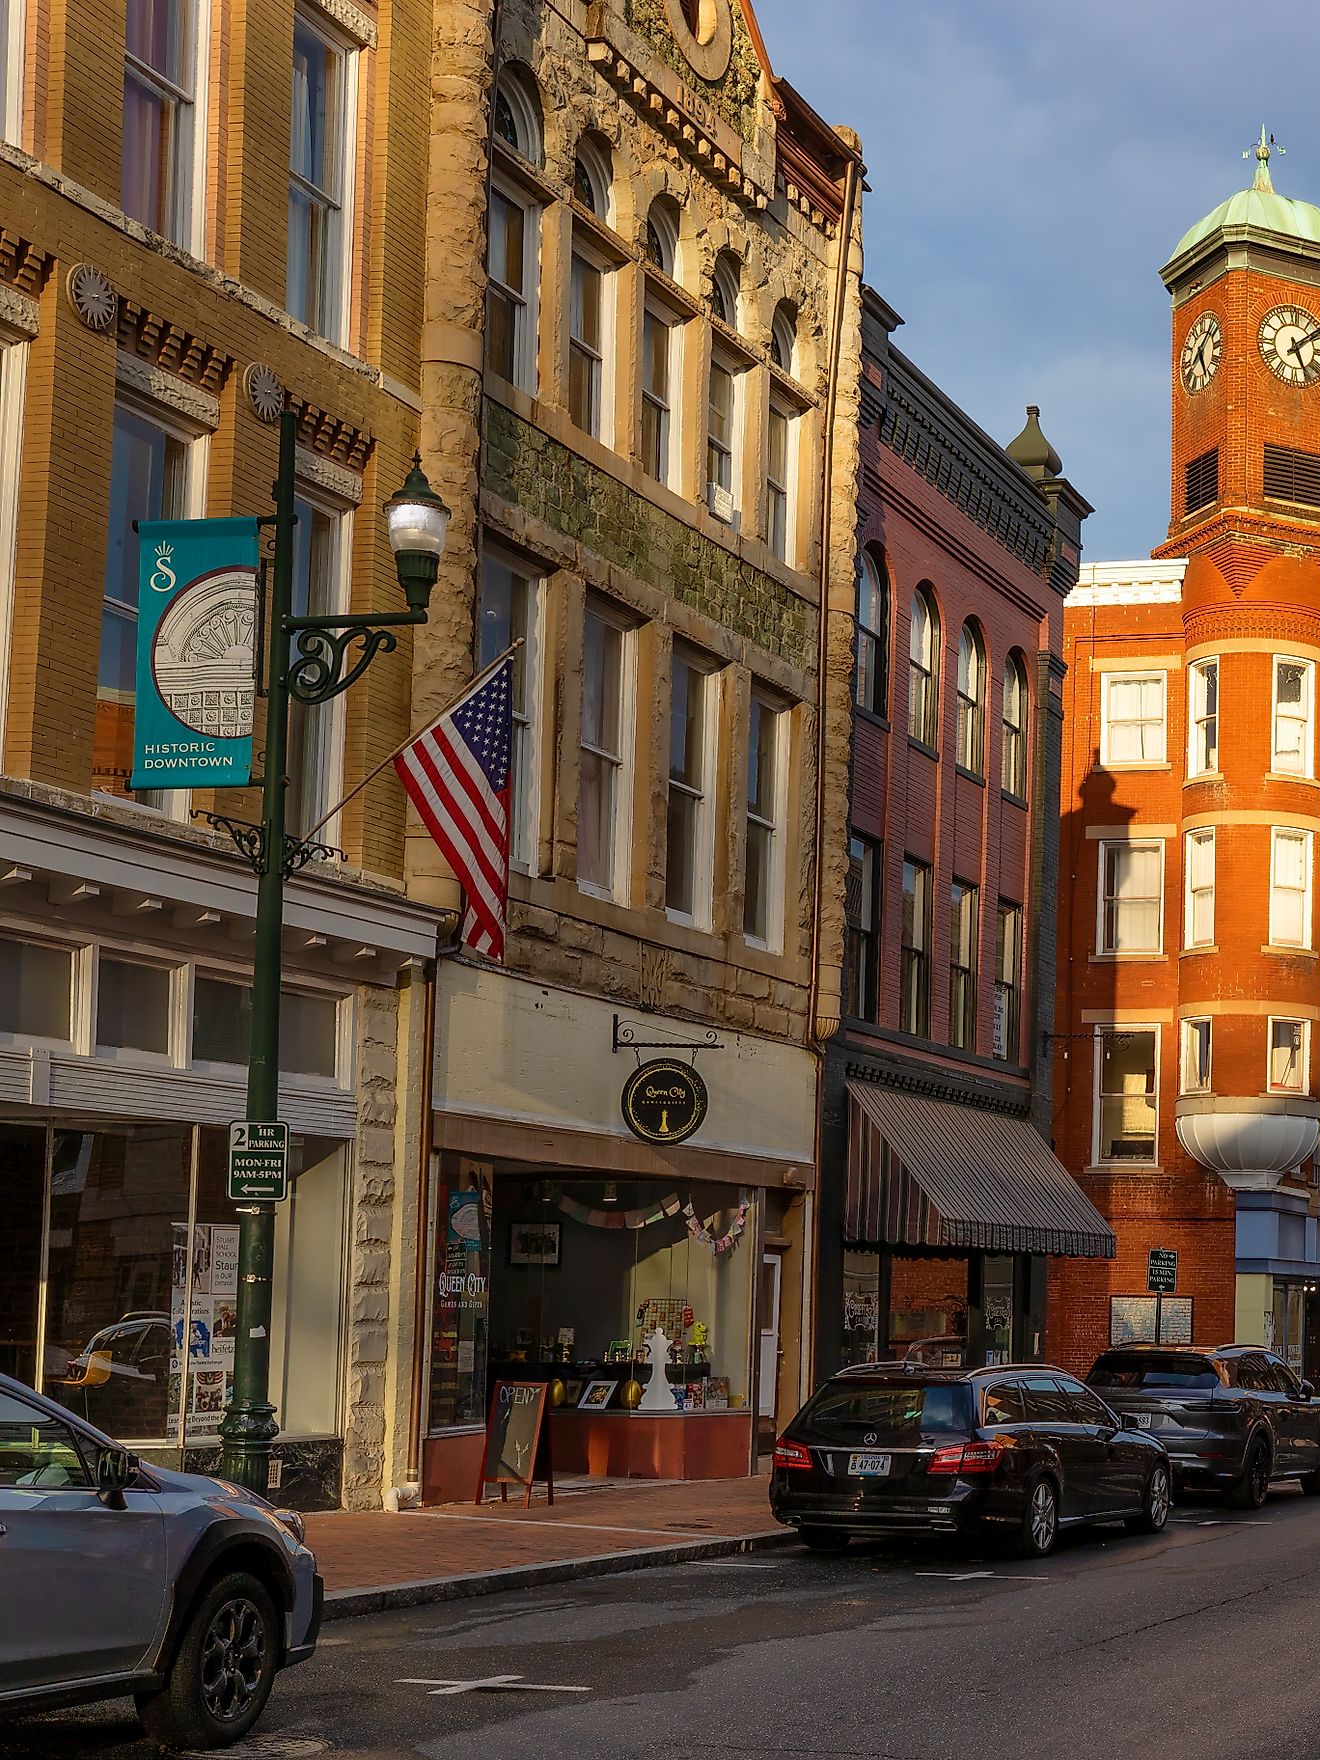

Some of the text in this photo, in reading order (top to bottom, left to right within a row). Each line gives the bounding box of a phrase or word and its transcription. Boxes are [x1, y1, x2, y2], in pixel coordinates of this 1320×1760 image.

[150, 556, 176, 592] S
[145, 742, 216, 755] HISTORIC
[144, 756, 234, 769] DOWNTOWN
[232, 1127, 247, 1147] 2
[258, 1128, 275, 1137] HR
[248, 1140, 285, 1149] PARKING
[234, 1158, 282, 1168] MON-FRI
[233, 1170, 282, 1179] 9AM-5PM
[1150, 1259, 1176, 1267] PARKING
